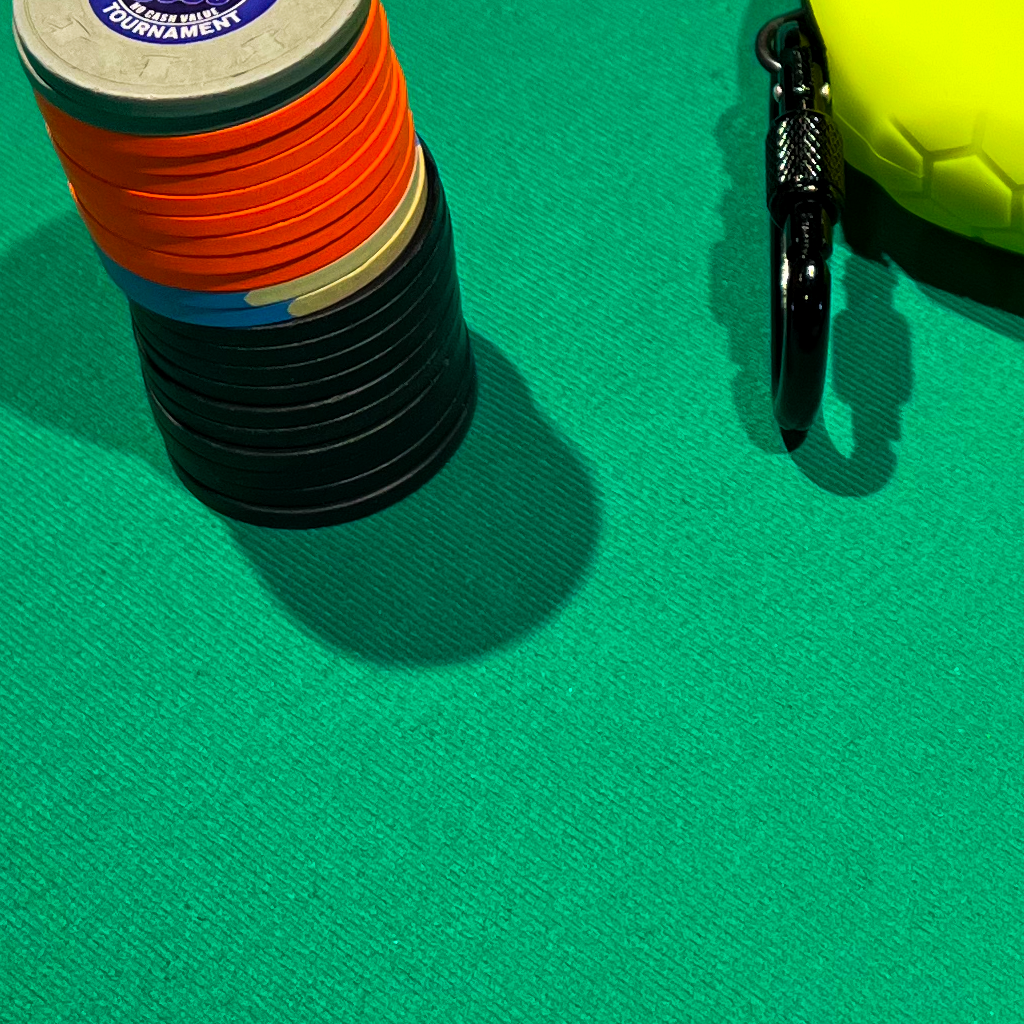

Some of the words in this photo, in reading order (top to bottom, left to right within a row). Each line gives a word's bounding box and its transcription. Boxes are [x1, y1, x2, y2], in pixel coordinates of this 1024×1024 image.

[102, 1, 242, 40] TOURNAMENT
[129, 1, 147, 15] NO
[144, 9, 178, 23] CASH
[179, 7, 220, 24] VALUE
